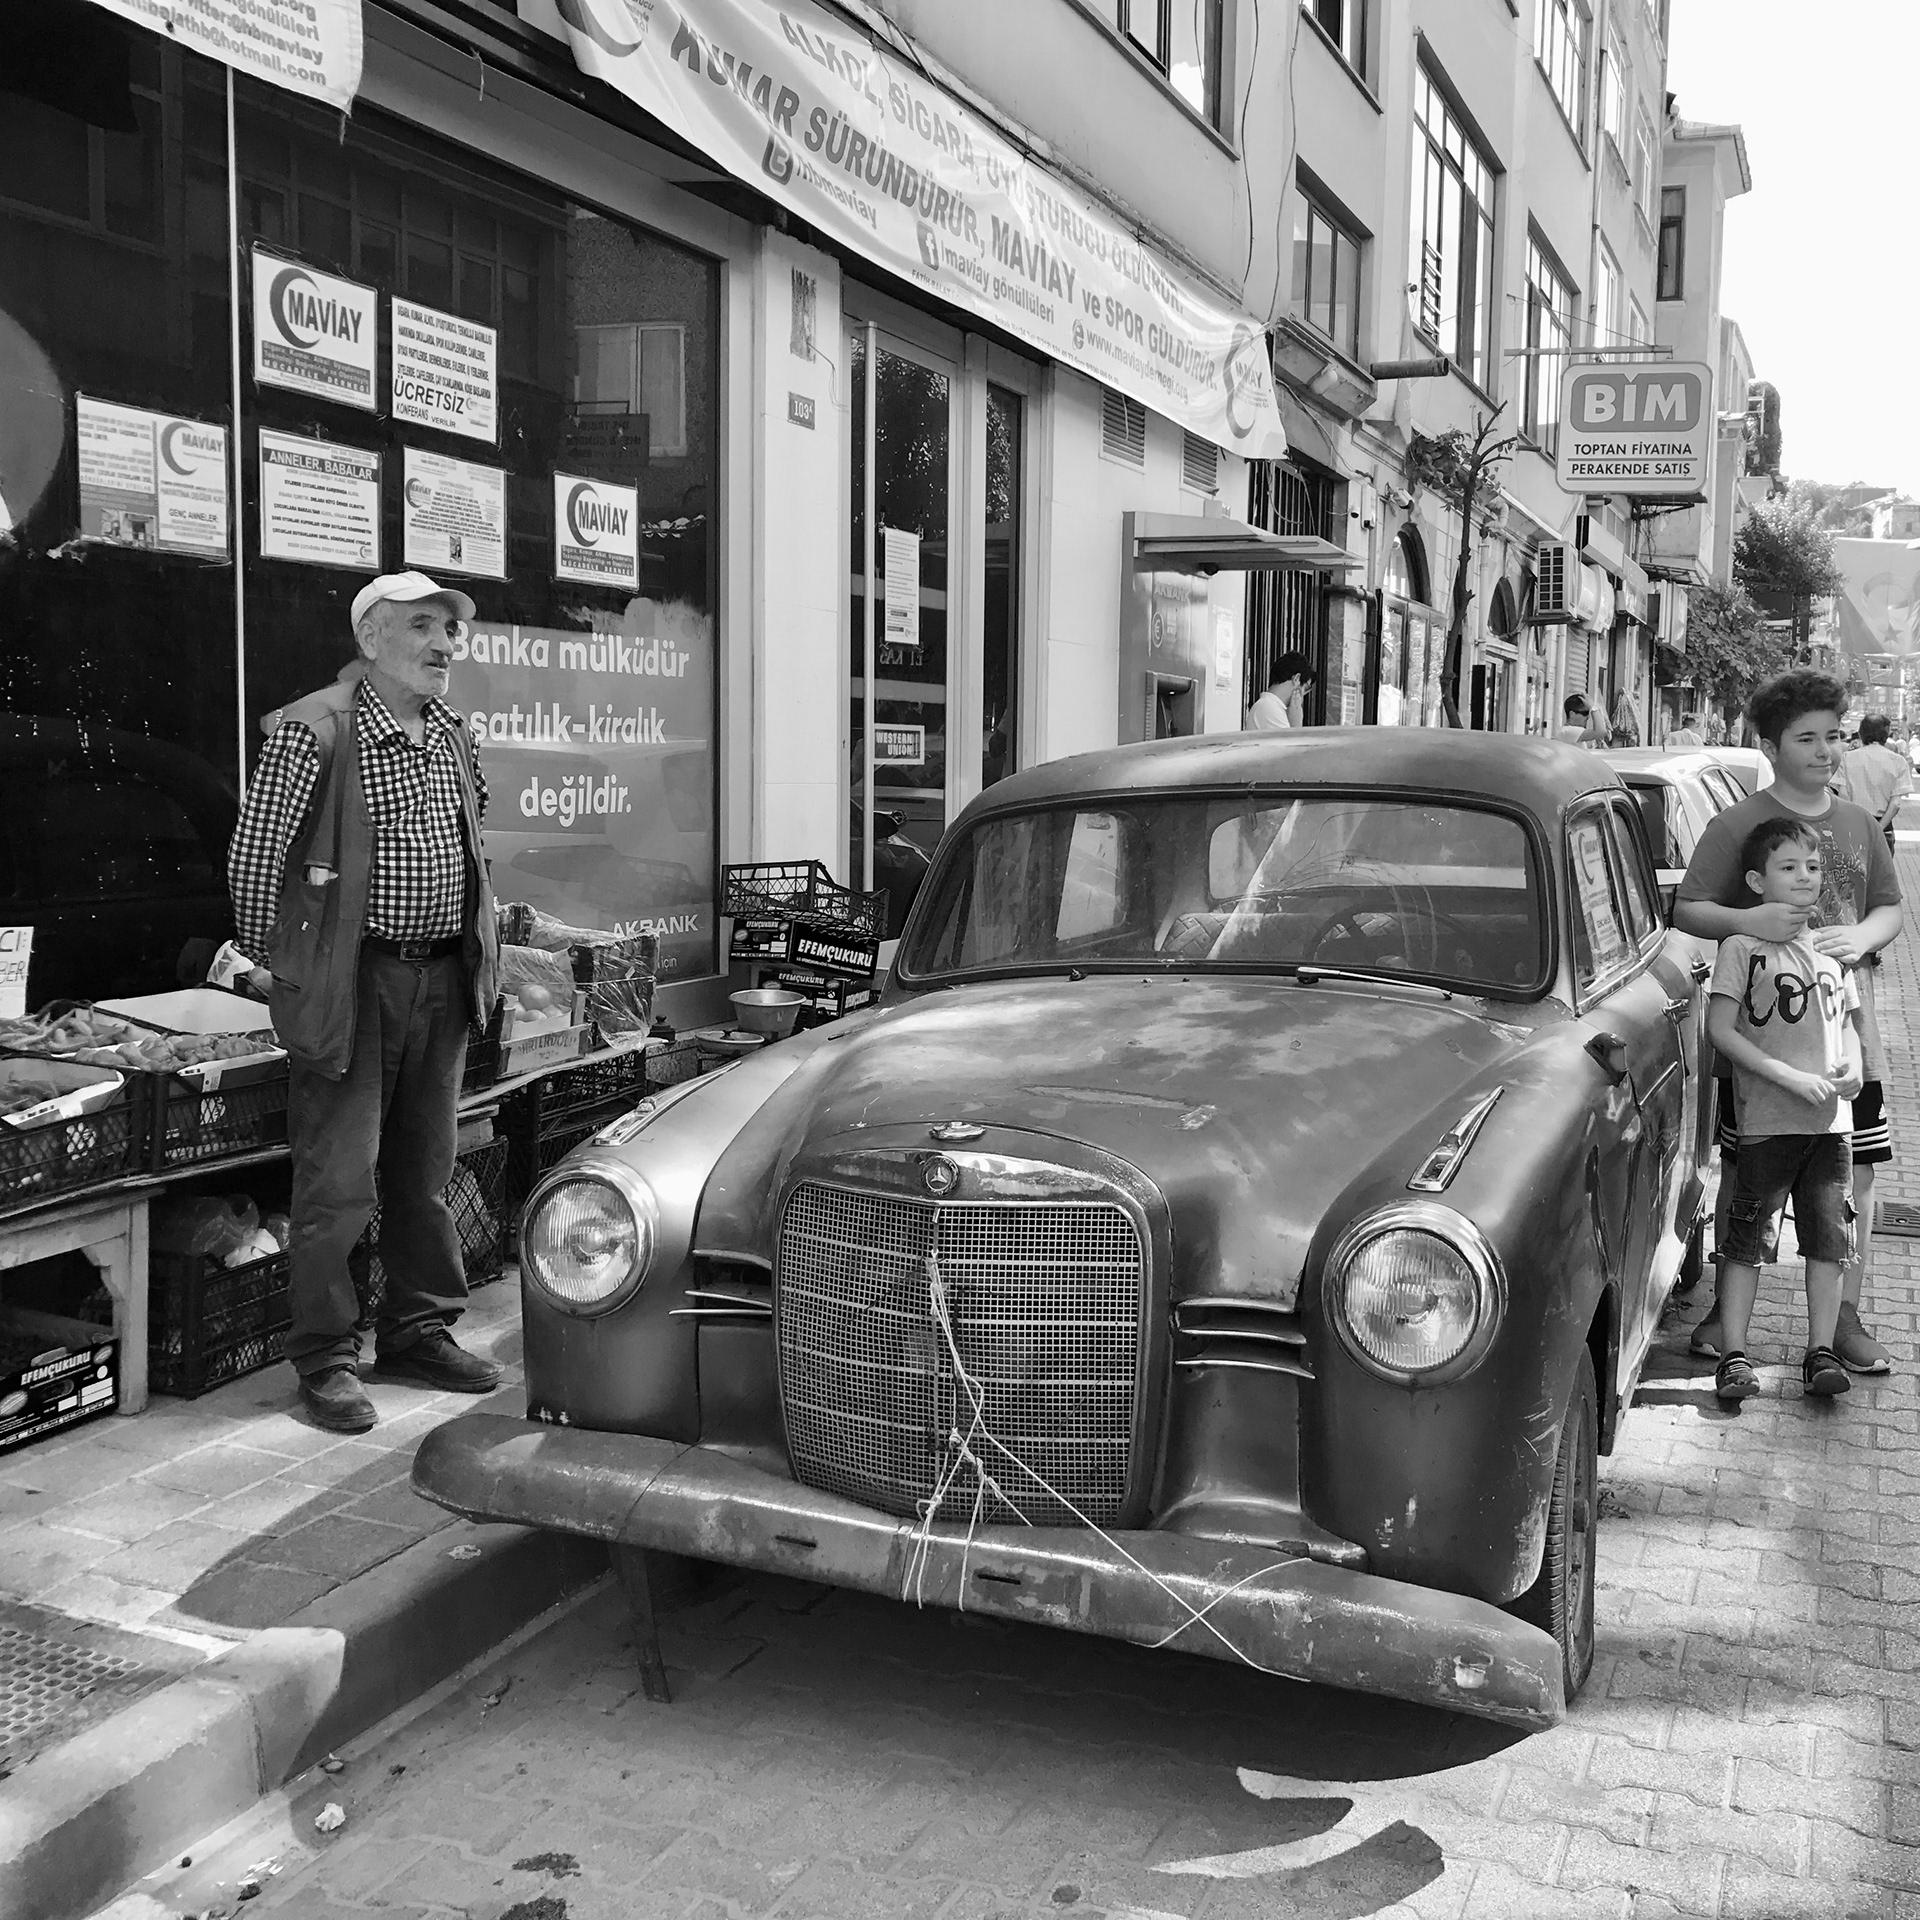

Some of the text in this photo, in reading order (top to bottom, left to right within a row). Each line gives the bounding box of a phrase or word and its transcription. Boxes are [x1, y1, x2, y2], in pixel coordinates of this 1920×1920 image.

[779, 12, 885, 119] ALKOL,
[889, 82, 981, 185] SİGARA,
[804, 106, 986, 259] SÜRÜNDÜRÜR,
[991, 214, 1076, 305] MAVİAY
[1081, 287, 1100, 320] ve
[1105, 295, 1144, 347] SPOR
[287, 289, 362, 344] MAVİAY
[993, 276, 1055, 325] gönüllüleri
[1086, 329, 1189, 404] www.maviaydernegi.org
[394, 374, 465, 415] ÜCRETSİZ
[396, 401, 429, 420] KONFERANS
[1584, 380, 1687, 423] BİM
[182, 432, 224, 453] MAVİAY
[1574, 441, 1692, 455] TOPTAN FİYATINA
[269, 450, 323, 472] ANNELER,
[324, 461, 373, 480] BABALAR
[1571, 463, 1690, 476] PERAKENDE SATIŞ
[168, 508, 187, 519] GENÇ
[578, 500, 629, 537] MAVİAY
[559, 632, 690, 678] mülküdür
[470, 702, 667, 745] satılık-kiralık
[875, 731, 913, 744] WESTERN
[888, 744, 913, 755] UNION
[519, 774, 633, 827] değildir.
[797, 938, 873, 968] EFEMÇUKURU
[778, 972, 825, 985] EFEMÇUKURU
[21, 1351, 91, 1386] EFEMÇUKURU
